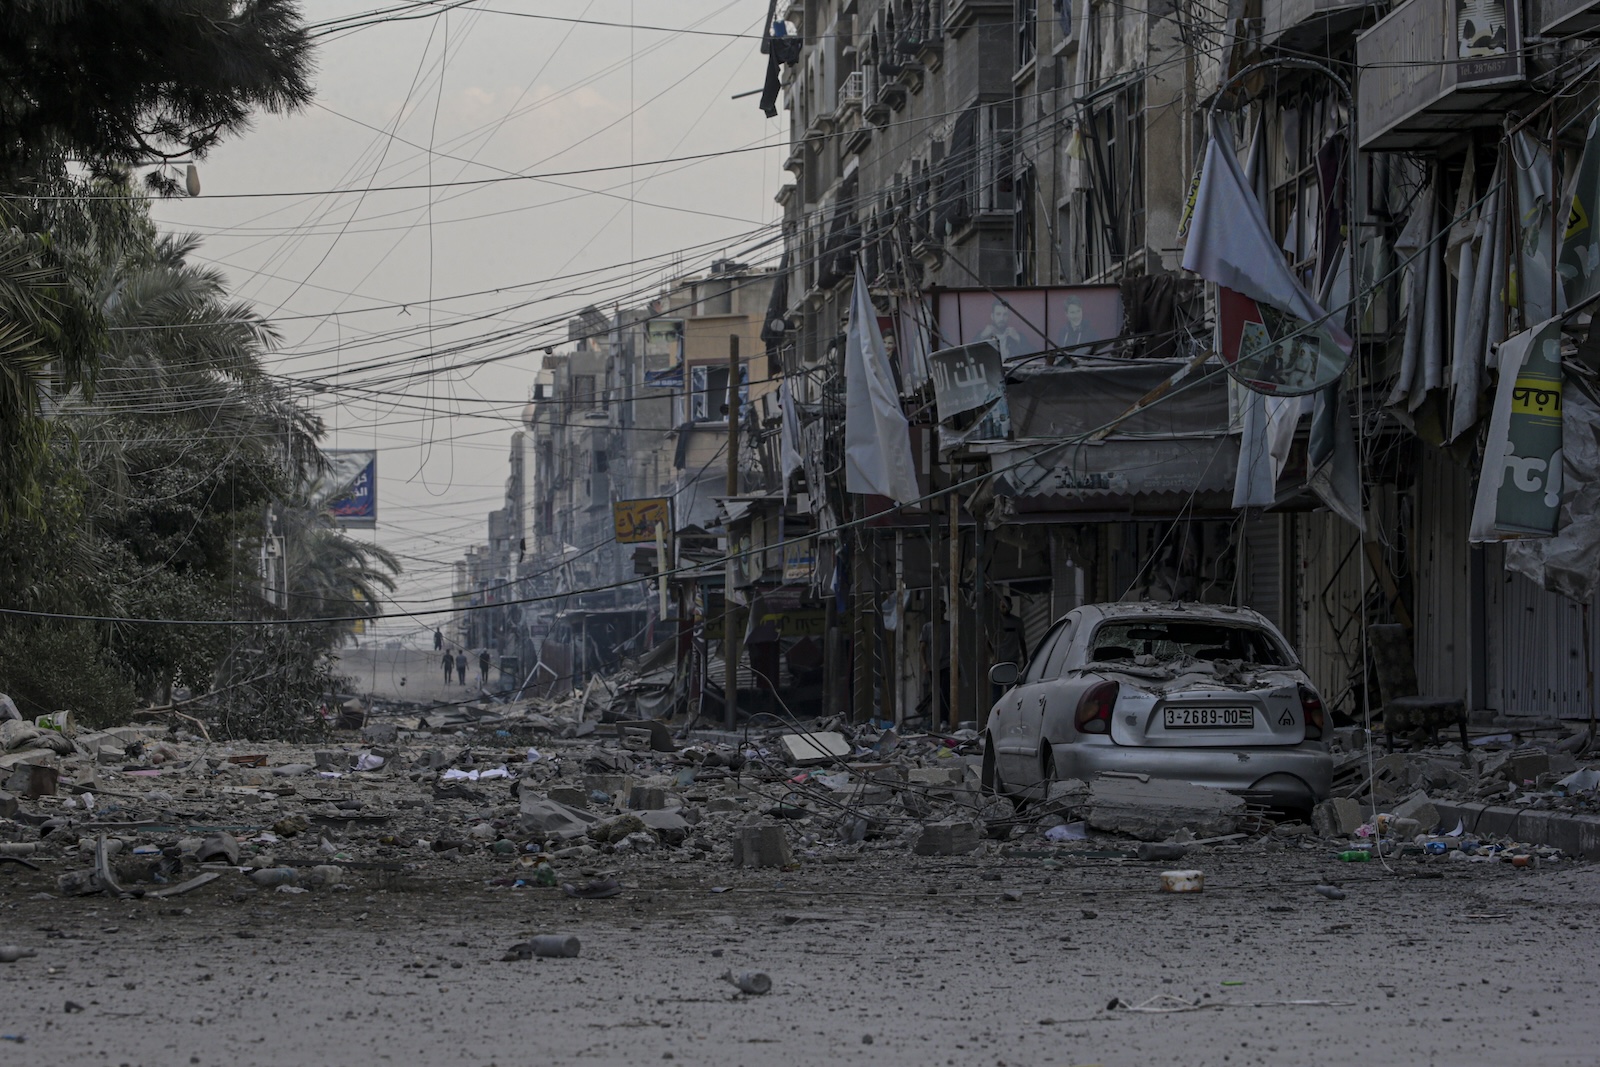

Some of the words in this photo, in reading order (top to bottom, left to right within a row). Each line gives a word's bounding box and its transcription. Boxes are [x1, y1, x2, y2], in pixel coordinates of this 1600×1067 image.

[1460, 64, 1472, 76] Tel.
[953, 357, 989, 390] بنت
[1167, 709, 1238, 724] 3-2689-00
